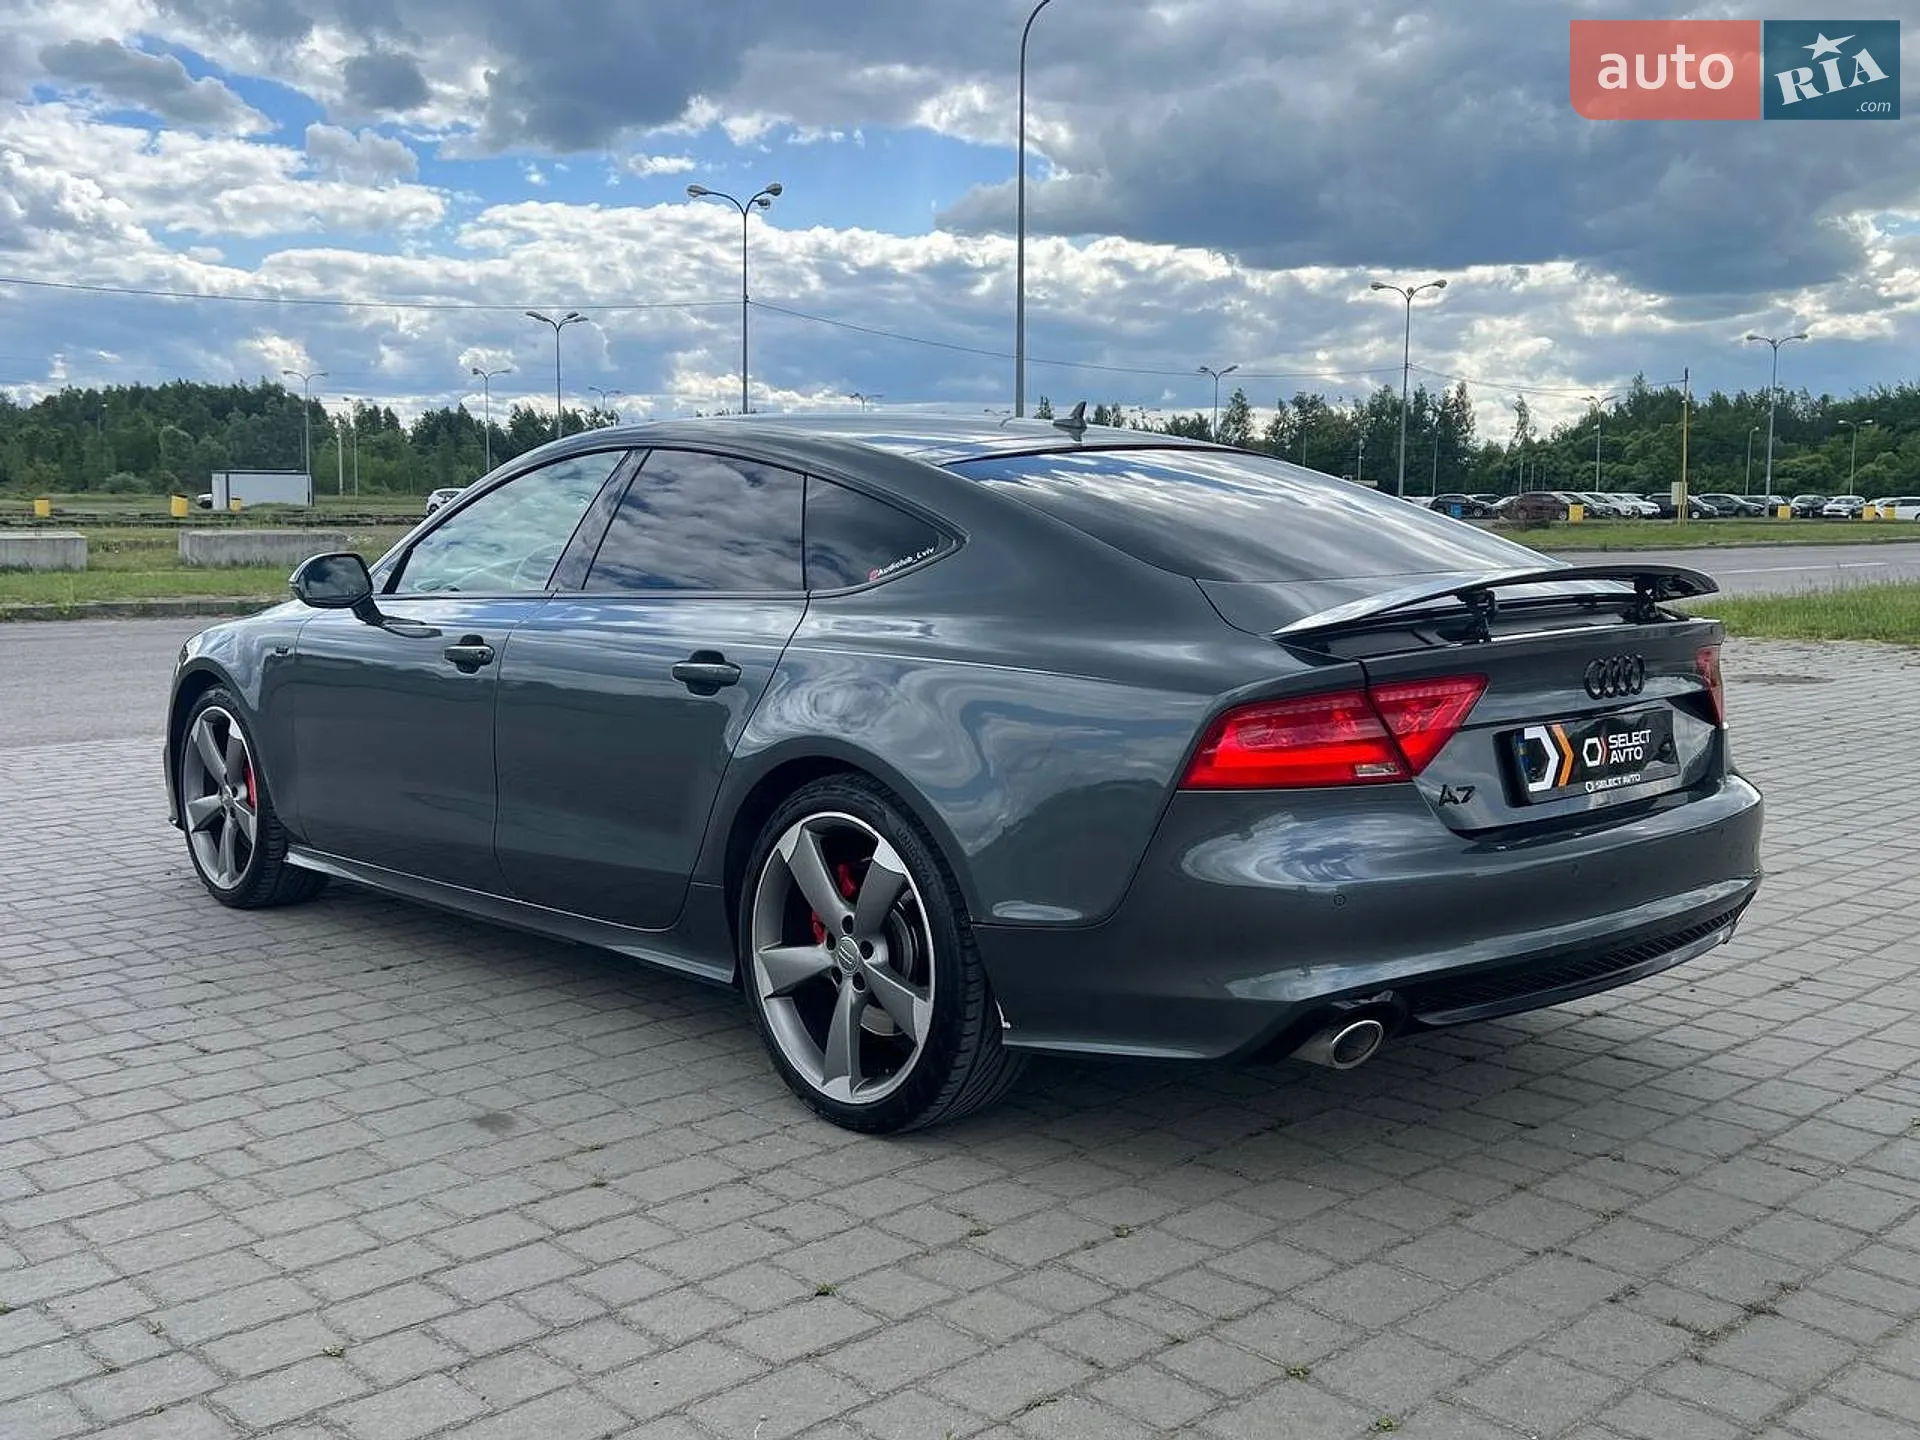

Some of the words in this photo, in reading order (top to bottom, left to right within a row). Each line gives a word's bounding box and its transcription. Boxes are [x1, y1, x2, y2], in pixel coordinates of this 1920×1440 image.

[1608, 729, 1652, 749] SELECT
[1610, 746, 1643, 764] AVTO
[1596, 777, 1622, 790] SELECT
[1439, 784, 1475, 806] A7
